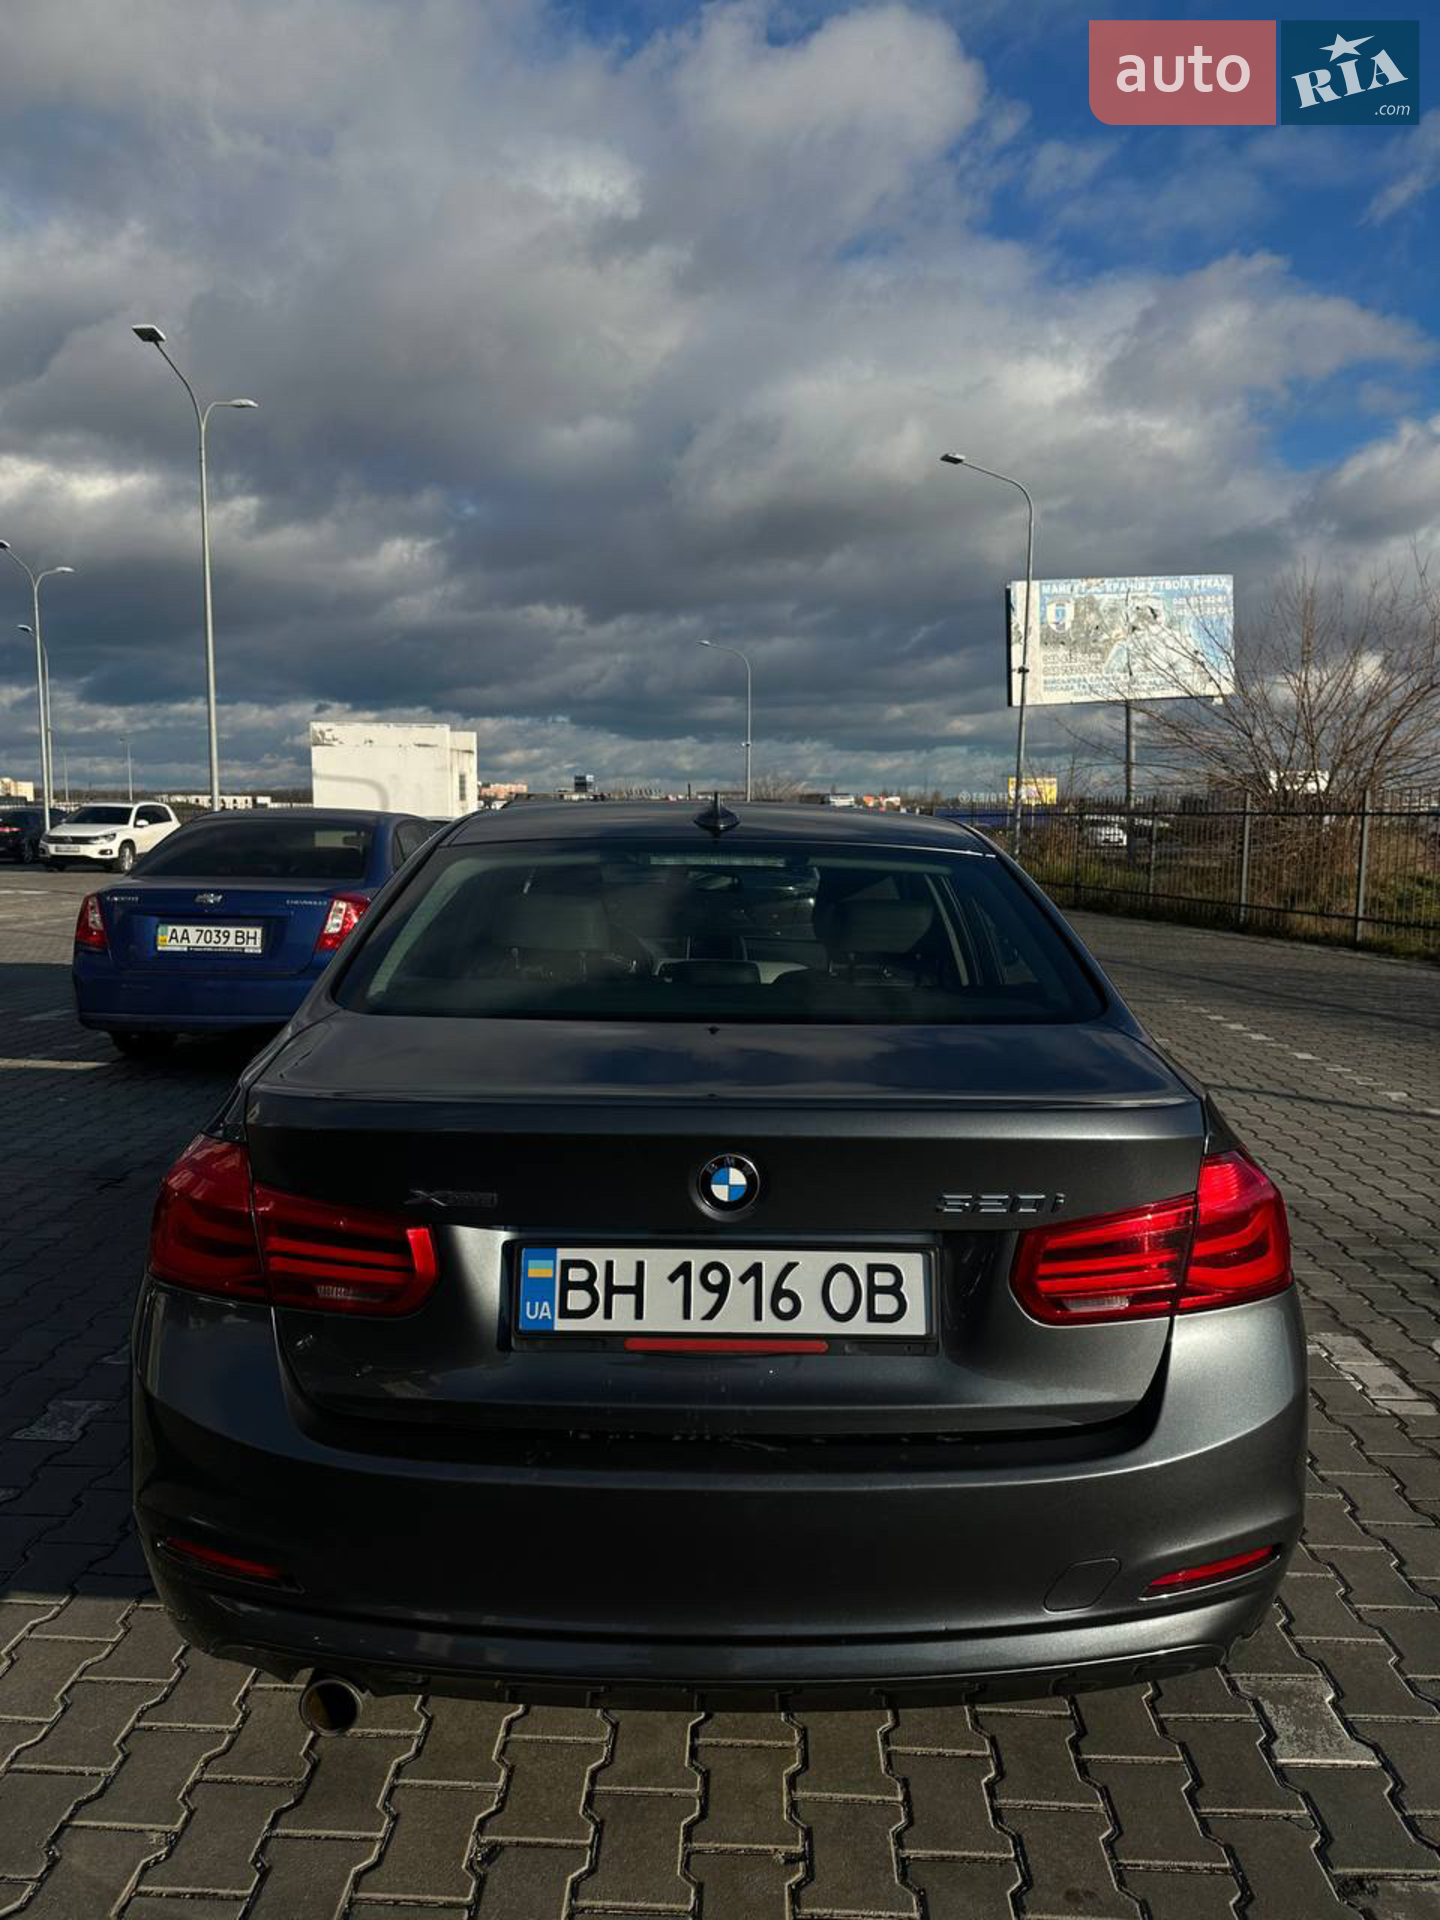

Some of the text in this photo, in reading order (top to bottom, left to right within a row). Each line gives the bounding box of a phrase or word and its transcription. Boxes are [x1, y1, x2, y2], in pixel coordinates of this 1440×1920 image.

[168, 928, 191, 944] AA
[195, 929, 231, 945] 7039
[234, 931, 257, 946] BH
[557, 1258, 909, 1324] BH 1916 OB
[525, 1301, 552, 1321] UA
